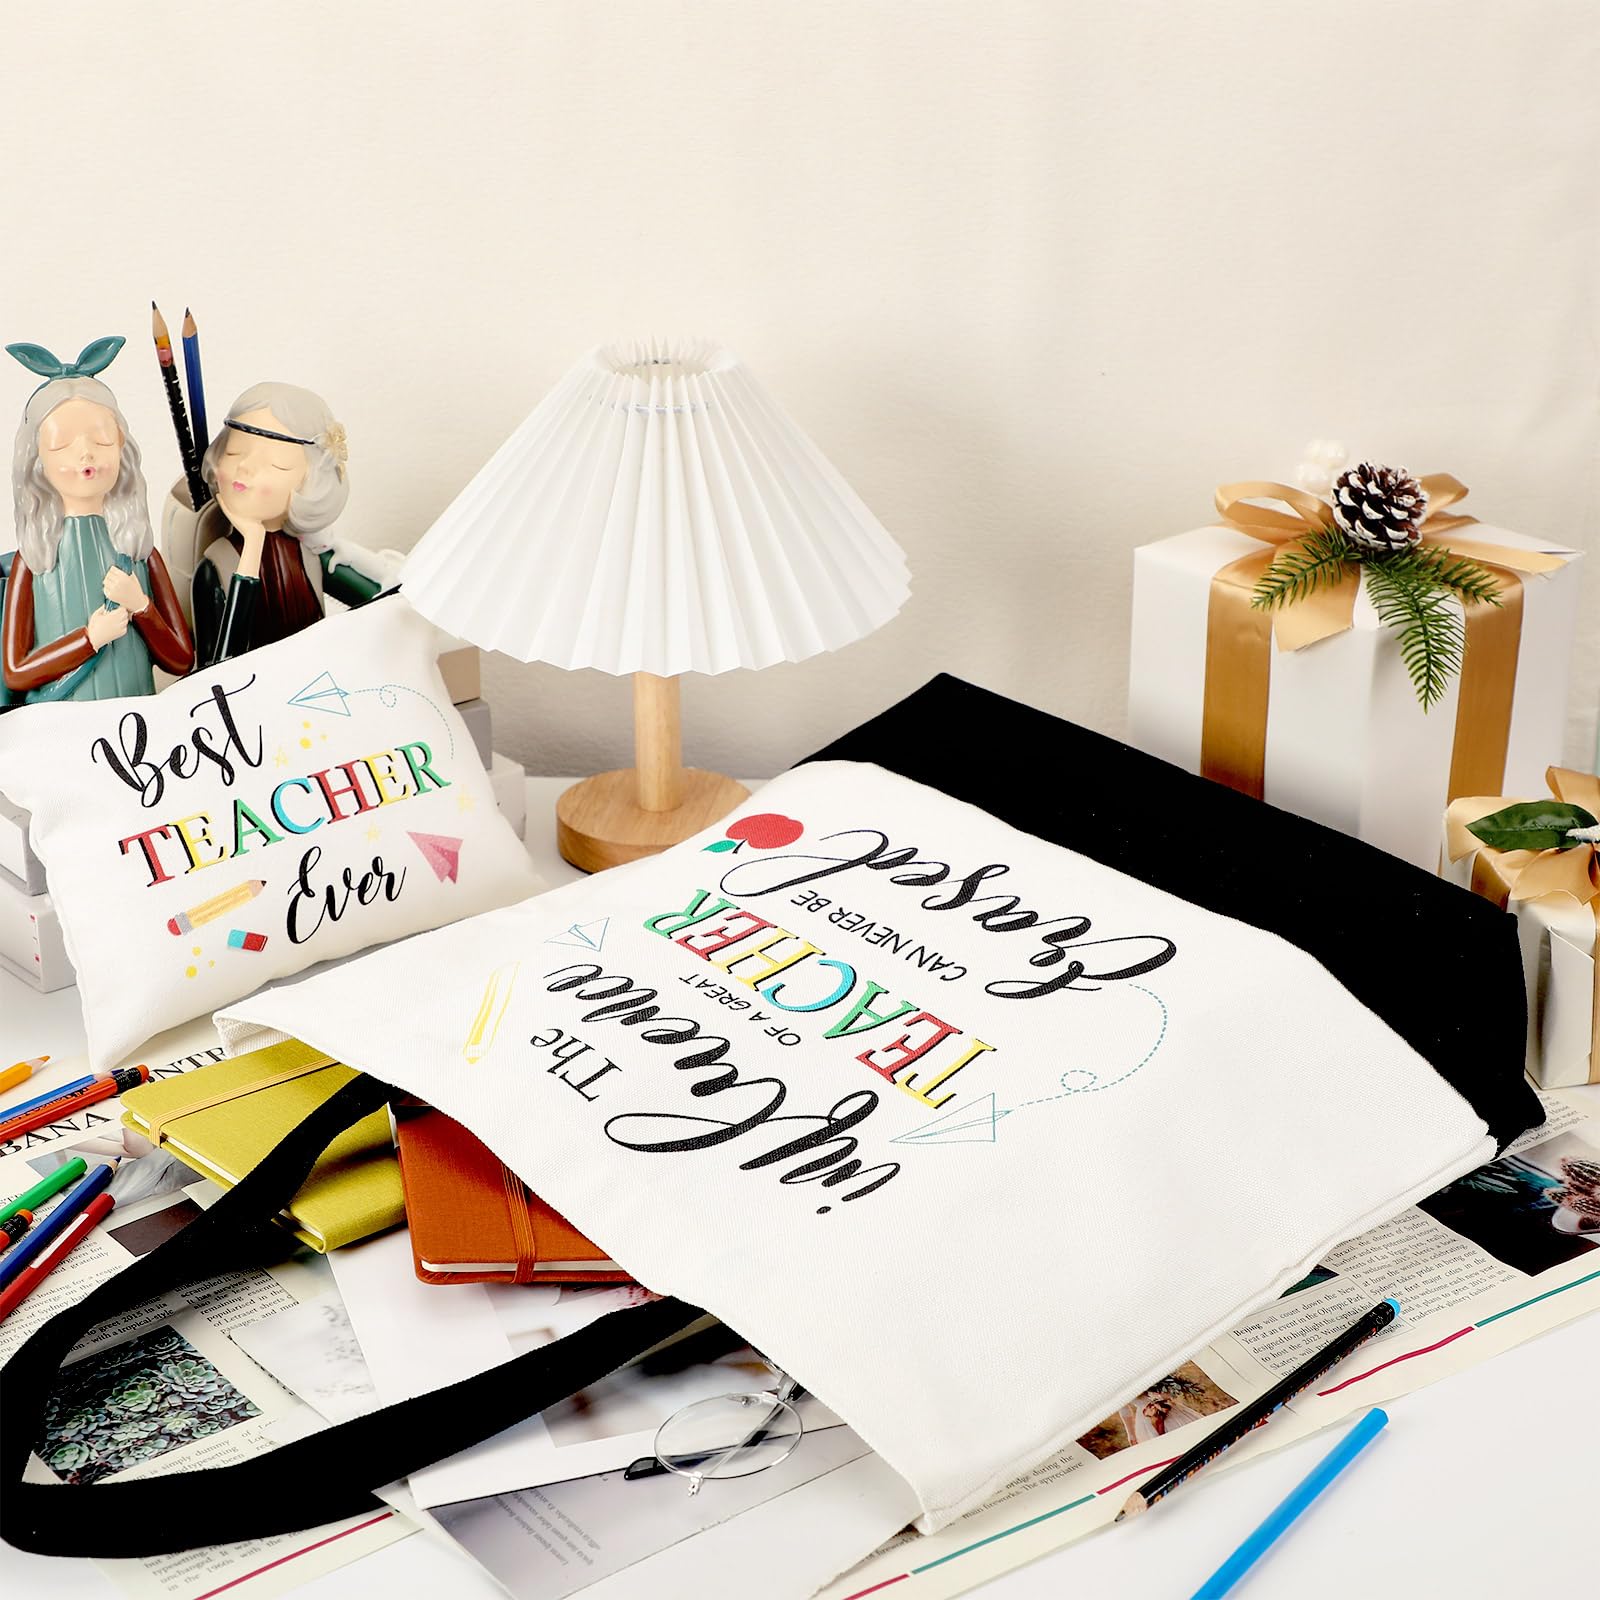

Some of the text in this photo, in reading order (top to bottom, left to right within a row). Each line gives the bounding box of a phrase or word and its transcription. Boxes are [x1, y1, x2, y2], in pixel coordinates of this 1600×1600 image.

[91, 673, 263, 808] Best
[118, 740, 452, 888] TEACHER
[286, 845, 407, 945] Ever
[719, 829, 1178, 1000] Erased
[790, 890, 968, 982] CAN NEVER BE
[642, 888, 998, 1110] TEACHER
[678, 973, 801, 1046] OF A GREAT
[530, 1028, 623, 1103] The
[543, 963, 901, 1215] influence
[1391, 1214, 1420, 1225] beaches
[1333, 1245, 1358, 1258] Brazil,
[1403, 1220, 1429, 1231] Sydney
[1357, 1248, 1372, 1257] and
[1382, 1230, 1418, 1250] potentially
[1362, 1262, 1392, 1274] welcome
[1366, 1256, 1375, 1264] of
[1387, 1247, 1409, 1256] Vegas
[1368, 1274, 1386, 1284] how
[1386, 1269, 1400, 1277] the
[1399, 1259, 1421, 1271] world
[1369, 1282, 1397, 1295] Sydney
[1396, 1274, 1416, 1284] takes
[1415, 1265, 1434, 1277] pride
[1441, 1254, 1465, 1266] being
[1463, 1250, 1477, 1258] one
[1390, 1290, 1403, 1300] the
[1403, 1282, 1420, 1292] first
[1421, 1274, 1442, 1289] major
[1444, 1267, 1463, 1277] cities
[1473, 1257, 1486, 1265] the
[1418, 1283, 1449, 1296] welcome
[1448, 1276, 1465, 1286] each
[1464, 1270, 1480, 1280] new
[35, 1284, 71, 1298] looking
[180, 1276, 223, 1298] scrambled
[213, 1276, 248, 1295] survived
[230, 1285, 250, 1294] leap
[1409, 1304, 1444, 1322] trademark
[1499, 1274, 1517, 1282] with
[37, 1300, 73, 1315] Sydney
[200, 1296, 243, 1315] remaining
[206, 1299, 255, 1322] popularised
[259, 1297, 285, 1309] sheets
[261, 1308, 277, 1318] and
[1233, 1286, 1355, 1336] Beijing will count down the New
[1422, 1296, 1442, 1307] plans
[121, 1310, 143, 1323] 2015
[1241, 1335, 1260, 1344] Year
[1278, 1319, 1298, 1331] event
[1305, 1312, 1318, 1320] the
[1317, 1300, 1348, 1315] Olympic
[1346, 1293, 1365, 1304] Park
[1252, 1336, 1285, 1354] designed
[1290, 1321, 1324, 1338] highlight
[1360, 1301, 1375, 1311] bid
[90, 1332, 111, 1343] with
[1269, 1348, 1288, 1358] host
[1288, 1343, 1302, 1351] the
[1302, 1332, 1322, 1345] 2022
[1320, 1324, 1347, 1335] Winter
[1269, 1356, 1297, 1370] Skaters
[1298, 1347, 1315, 1356] will
[195, 1440, 229, 1456] dummy
[1032, 1455, 1073, 1476] during the
[1039, 1461, 1083, 1484] appreciative
